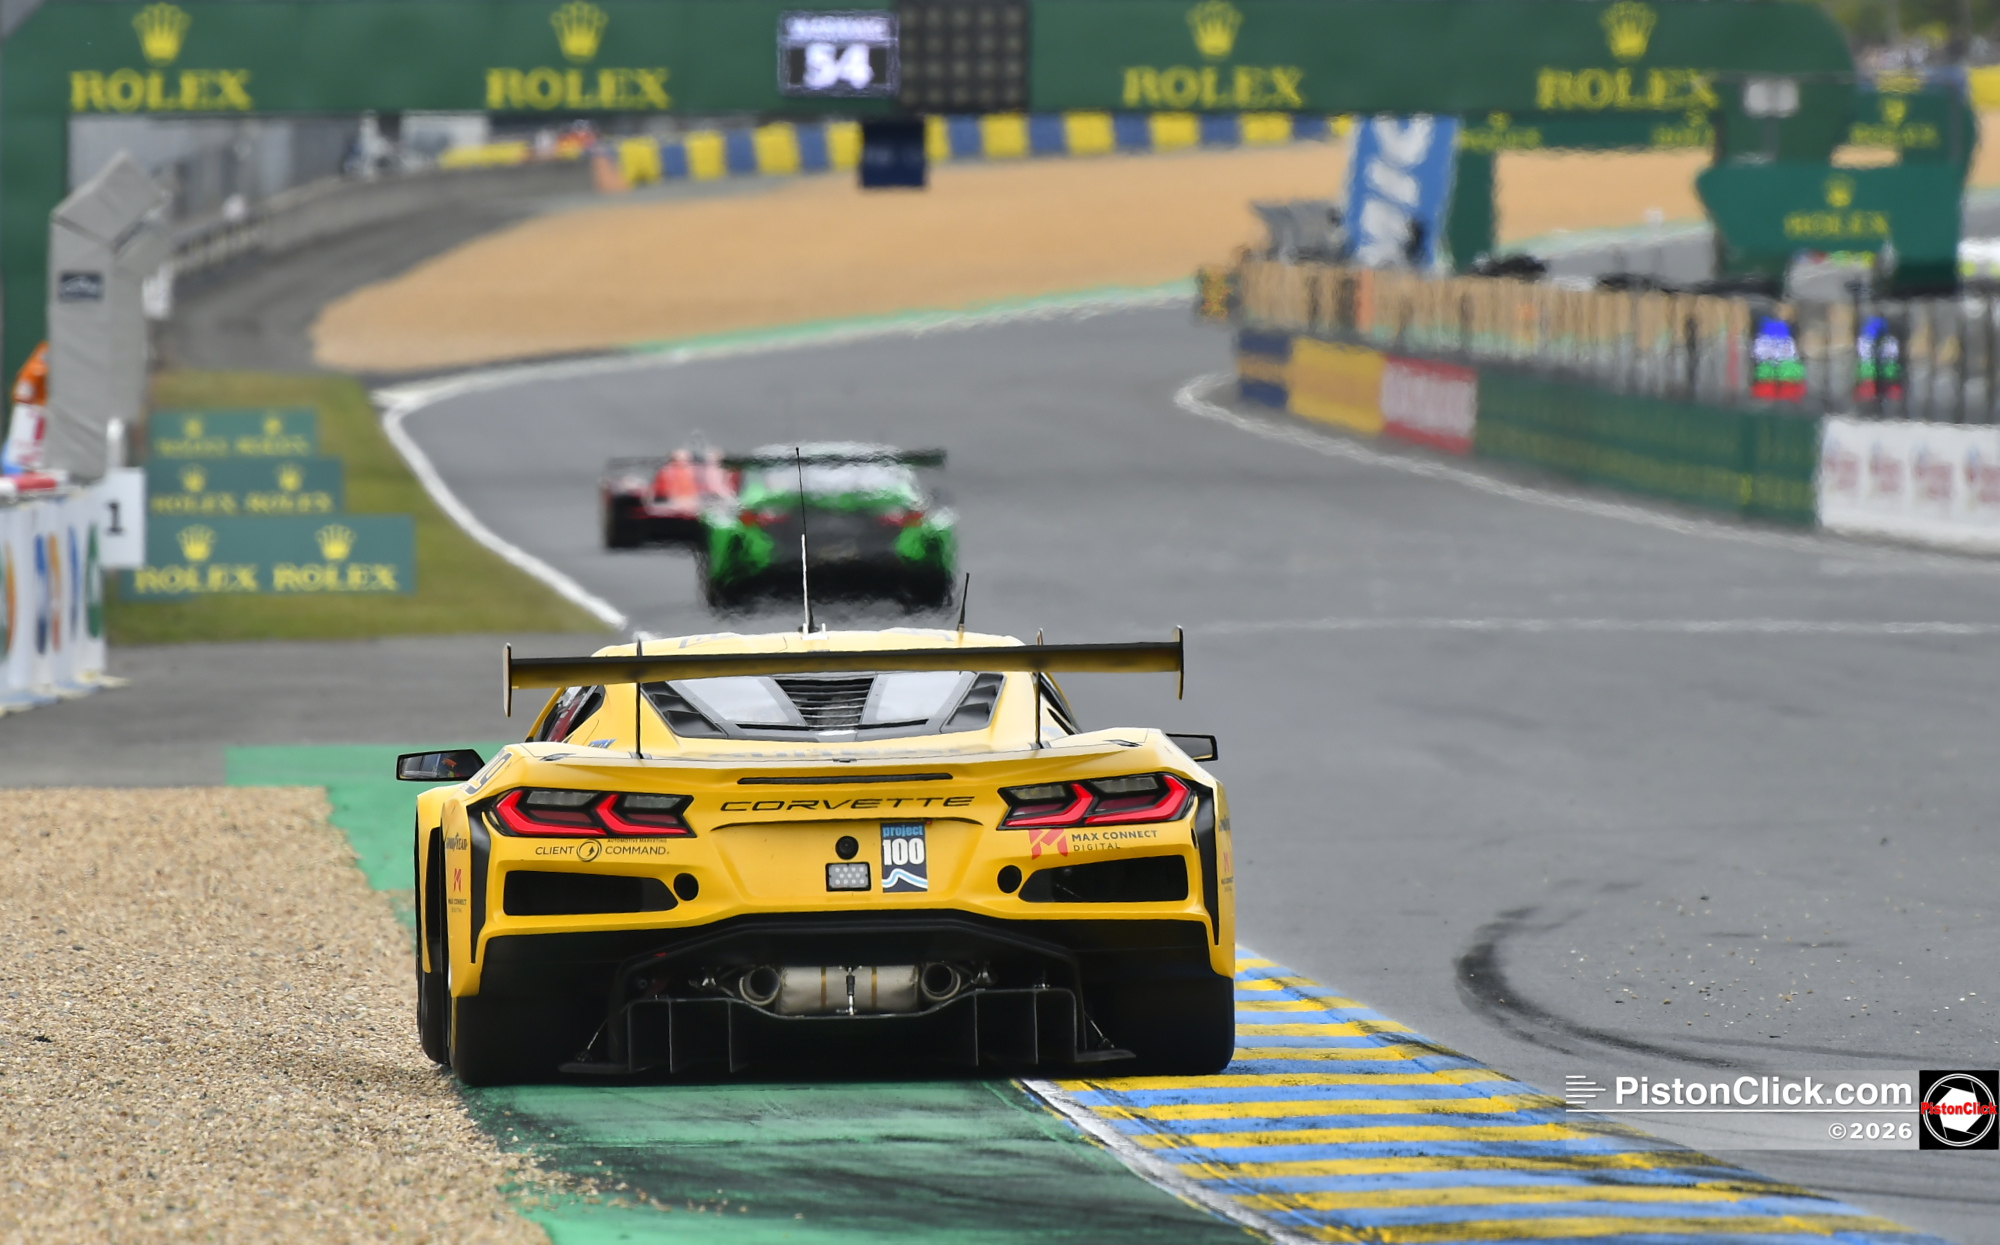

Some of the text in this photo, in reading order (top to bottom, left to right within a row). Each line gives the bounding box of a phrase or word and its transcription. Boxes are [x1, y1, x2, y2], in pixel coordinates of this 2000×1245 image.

[803, 42, 874, 90] 54
[70, 69, 252, 112] ROLEX
[484, 67, 670, 109] ROLEX
[1121, 66, 1303, 107] ROLEX
[1535, 67, 1718, 110] ROLEX
[106, 501, 124, 537] 1
[134, 562, 397, 594] ROLEX ROLEX
[720, 796, 975, 812] CORVETTE
[882, 825, 924, 837] project
[1072, 830, 1158, 842] MAX CONNECT
[1073, 843, 1121, 851] DIGITAL
[535, 846, 575, 855] CLIENT
[882, 838, 925, 866] 100
